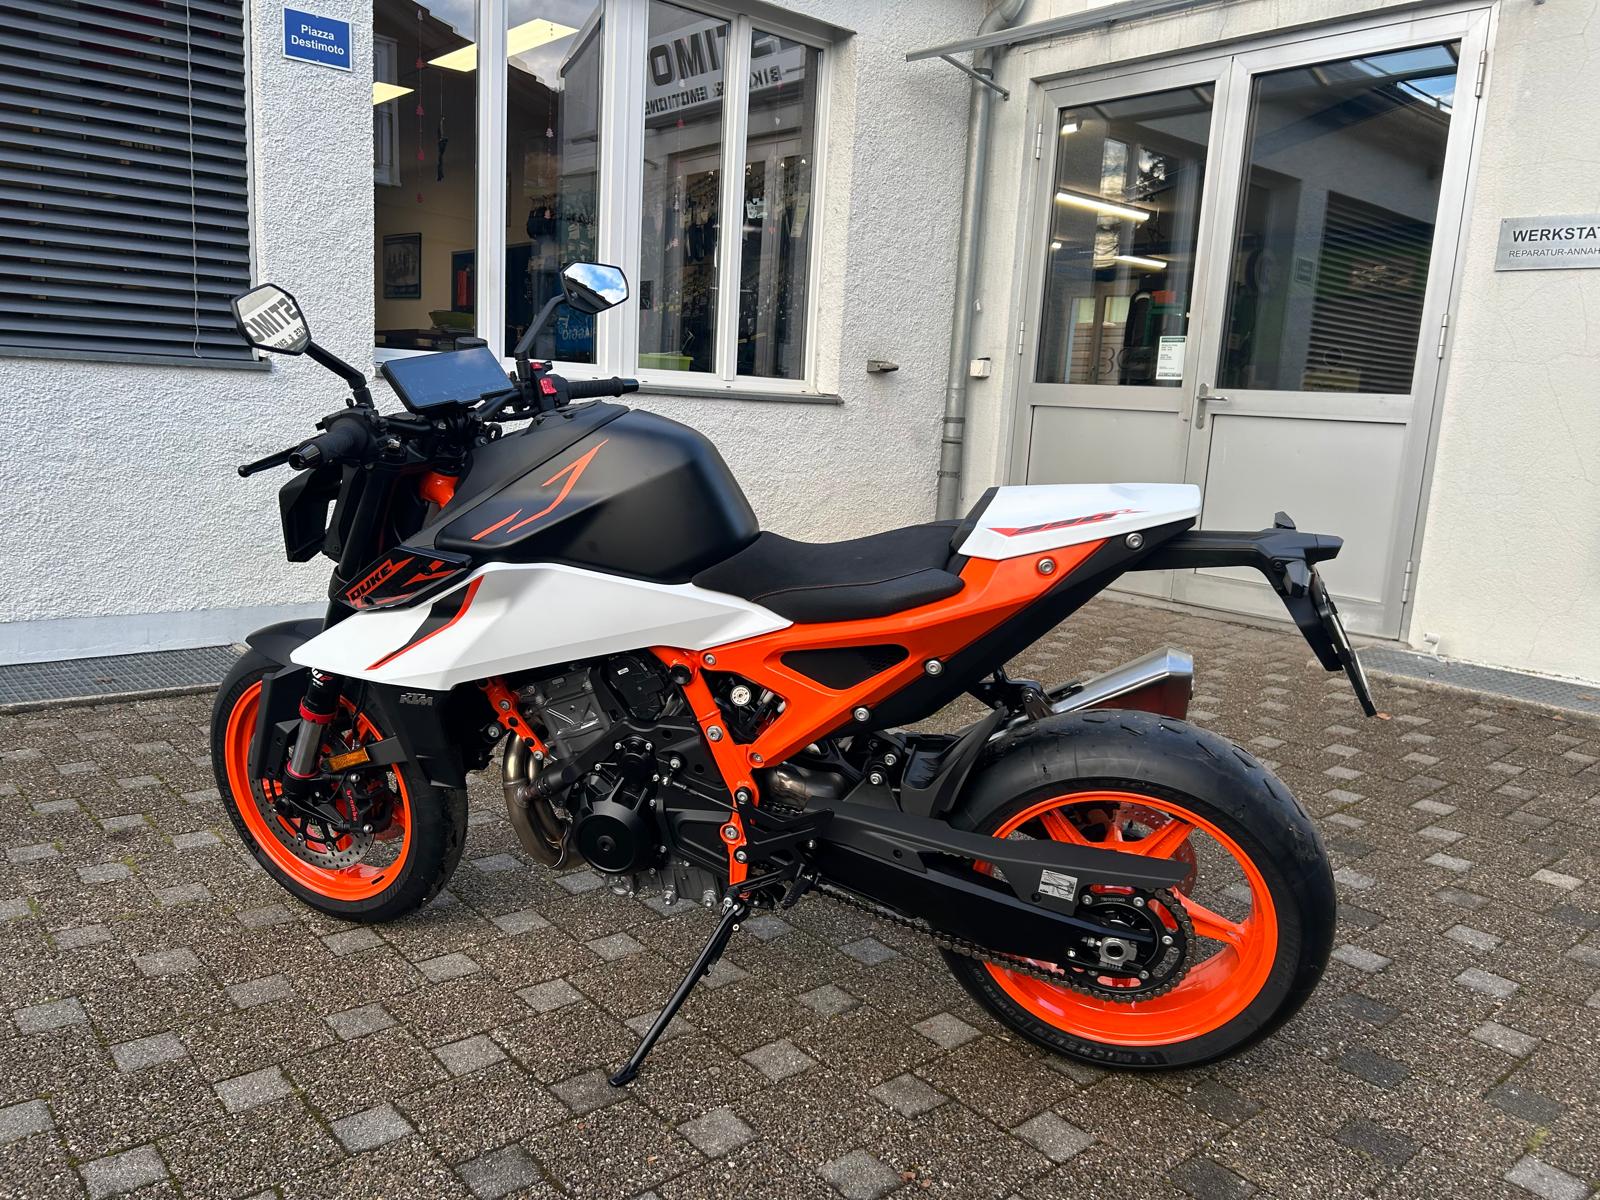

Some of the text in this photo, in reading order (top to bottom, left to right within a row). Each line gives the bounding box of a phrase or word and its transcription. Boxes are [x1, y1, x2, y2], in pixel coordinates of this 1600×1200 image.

[301, 24, 335, 41] Piazza
[291, 34, 345, 56] Destimoto
[350, 563, 392, 602] DUKE
[400, 692, 434, 707] KTM
[346, 788, 359, 822] brembo
